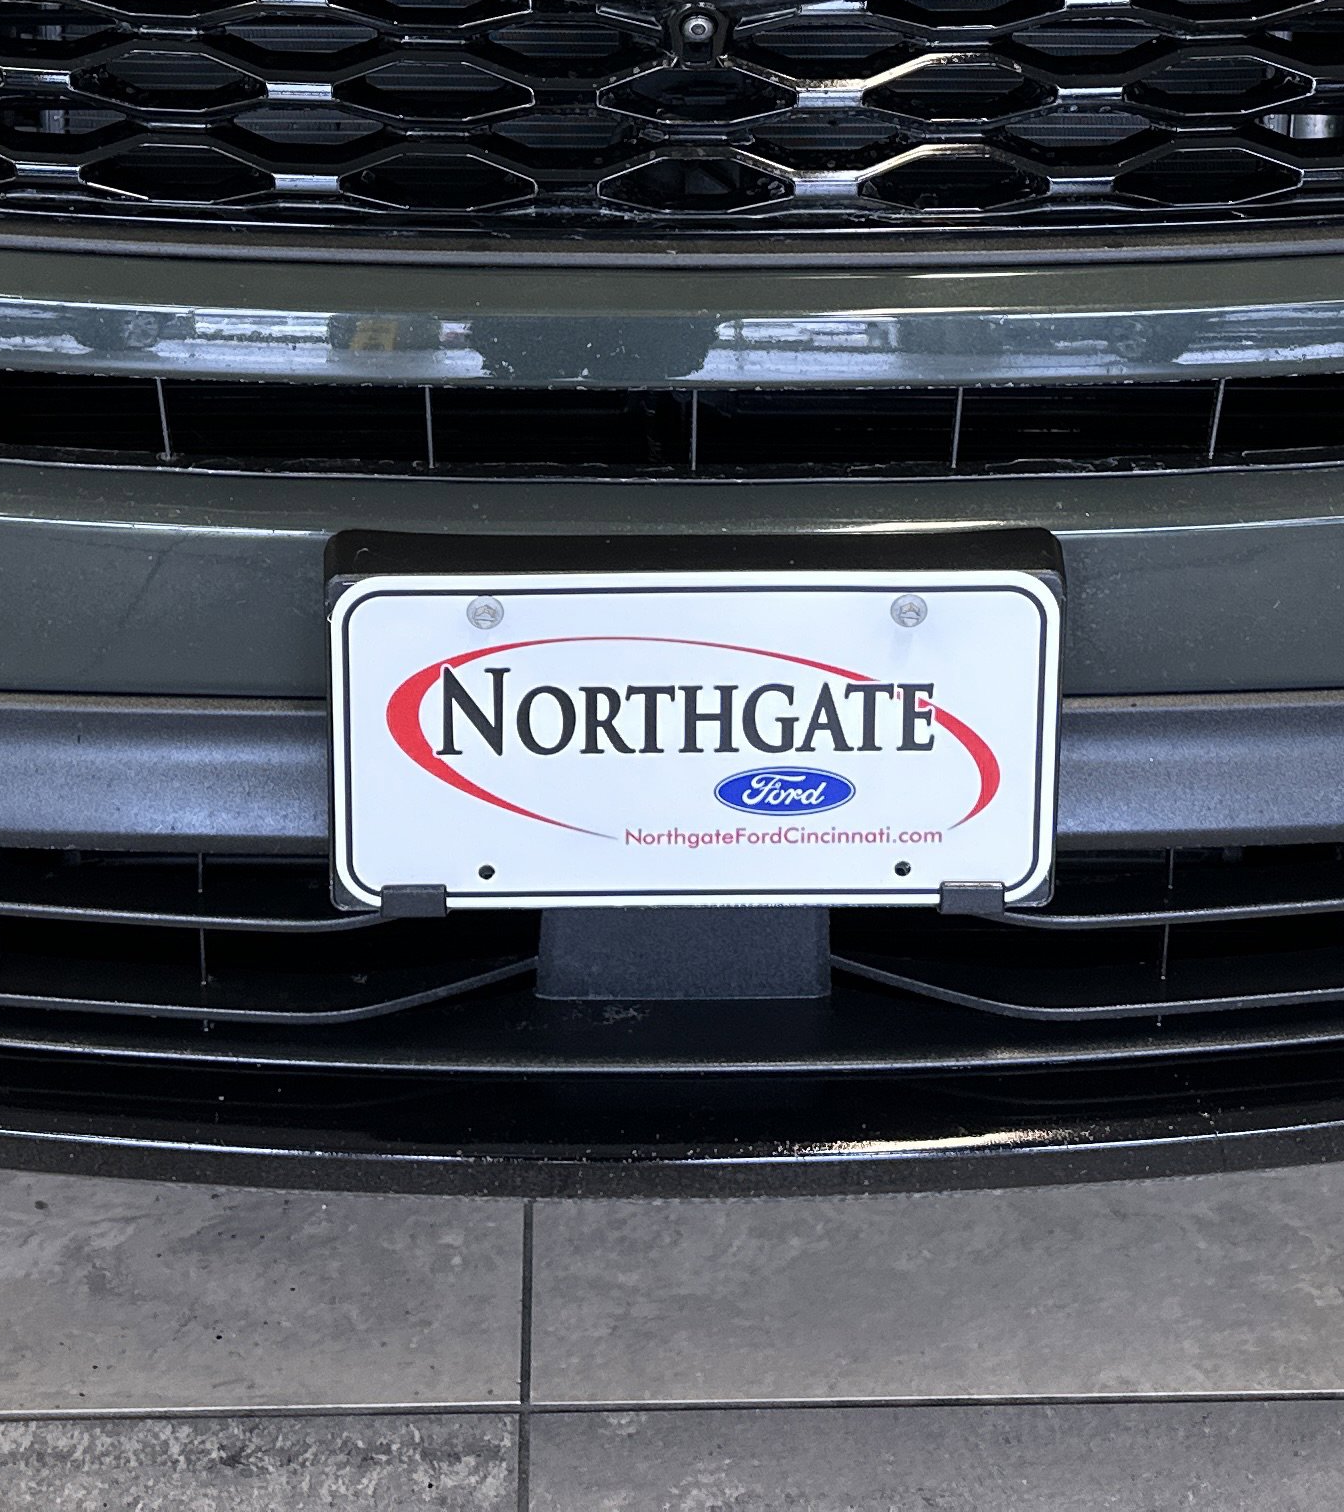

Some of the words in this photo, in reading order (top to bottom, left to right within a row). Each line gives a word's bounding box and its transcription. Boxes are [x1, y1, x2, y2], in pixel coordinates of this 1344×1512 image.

[437, 667, 935, 756] NORTHGATE
[742, 775, 827, 806] Ford
[625, 826, 943, 848] NorthgateFordCincinnati.com
